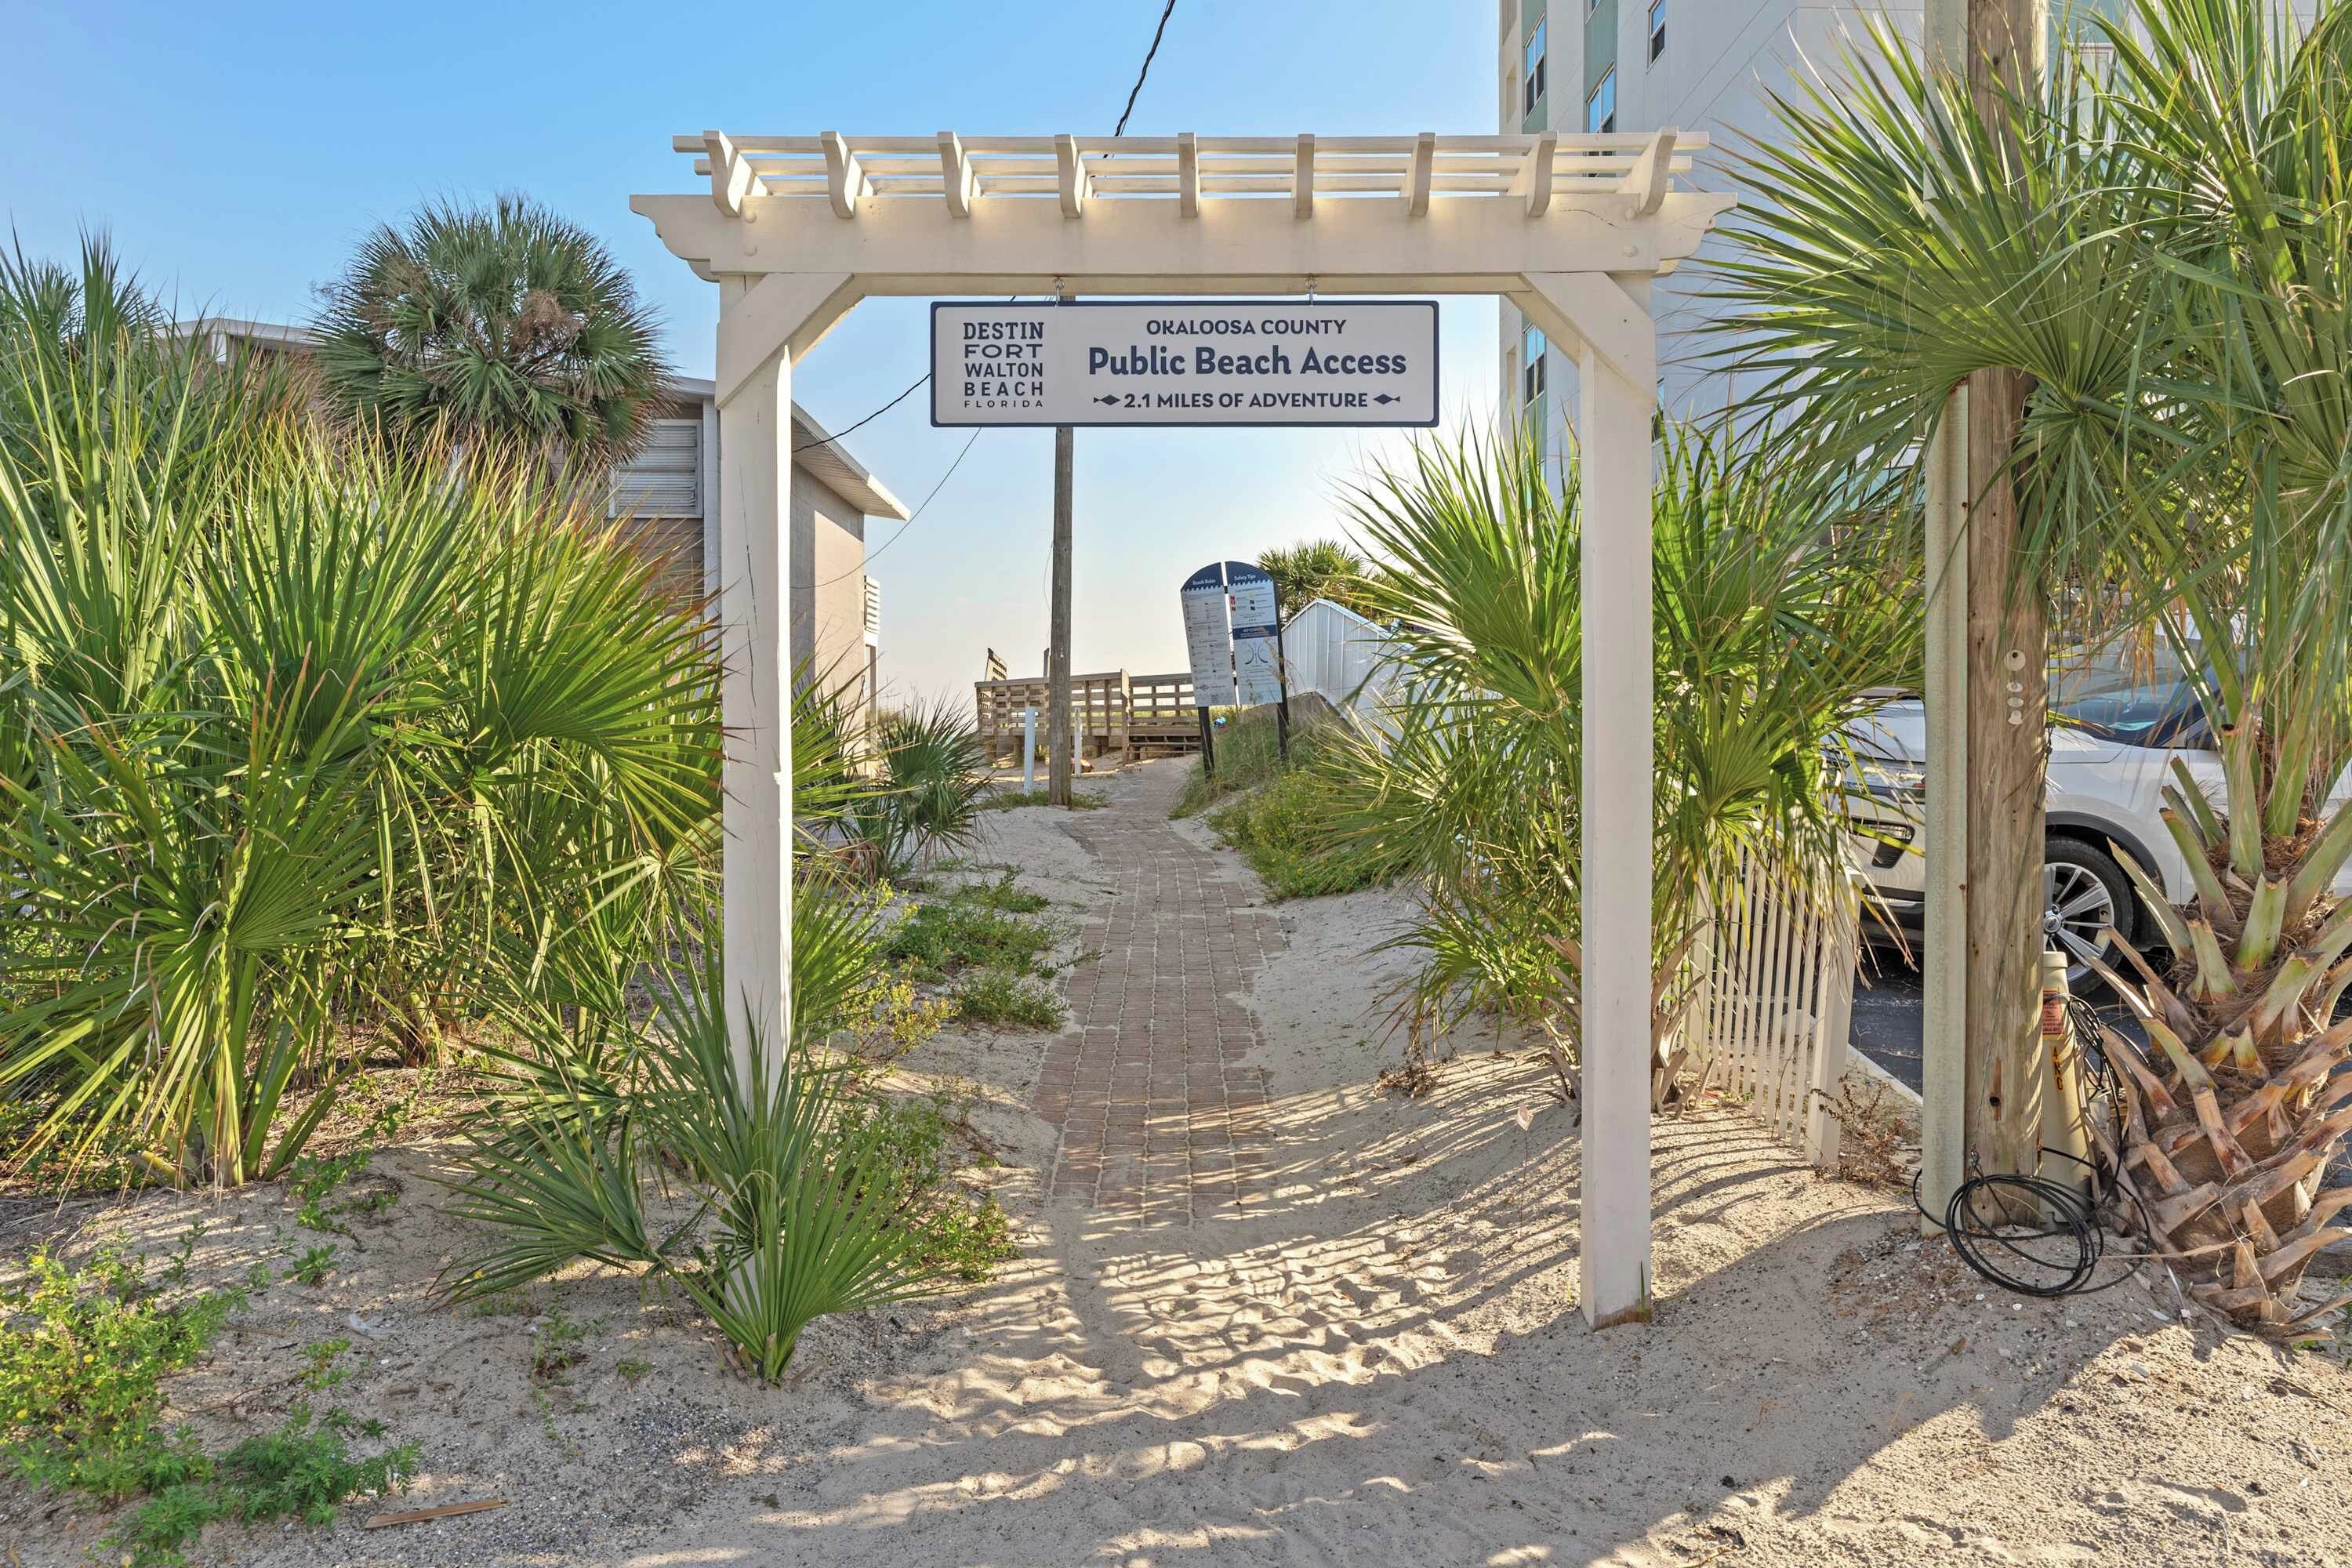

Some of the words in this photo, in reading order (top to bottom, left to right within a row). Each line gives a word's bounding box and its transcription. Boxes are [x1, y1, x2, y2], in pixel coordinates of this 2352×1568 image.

[963, 321, 1044, 339] DESTIN
[1146, 319, 1255, 335] OKALOOSA
[1261, 319, 1347, 335] COUNTY
[964, 343, 1044, 358] FORT
[1088, 345, 1186, 376] Public
[1195, 346, 1291, 376] Beach
[1300, 347, 1407, 376] Access
[964, 362, 1044, 377] WALTON
[964, 381, 1044, 397] BEACH
[964, 400, 1044, 408] FLORIDA
[1123, 394, 1151, 408] 2.1
[1157, 394, 1215, 408] MILES
[1218, 394, 1246, 408] OF
[1249, 394, 1369, 408] ADVENTURE
